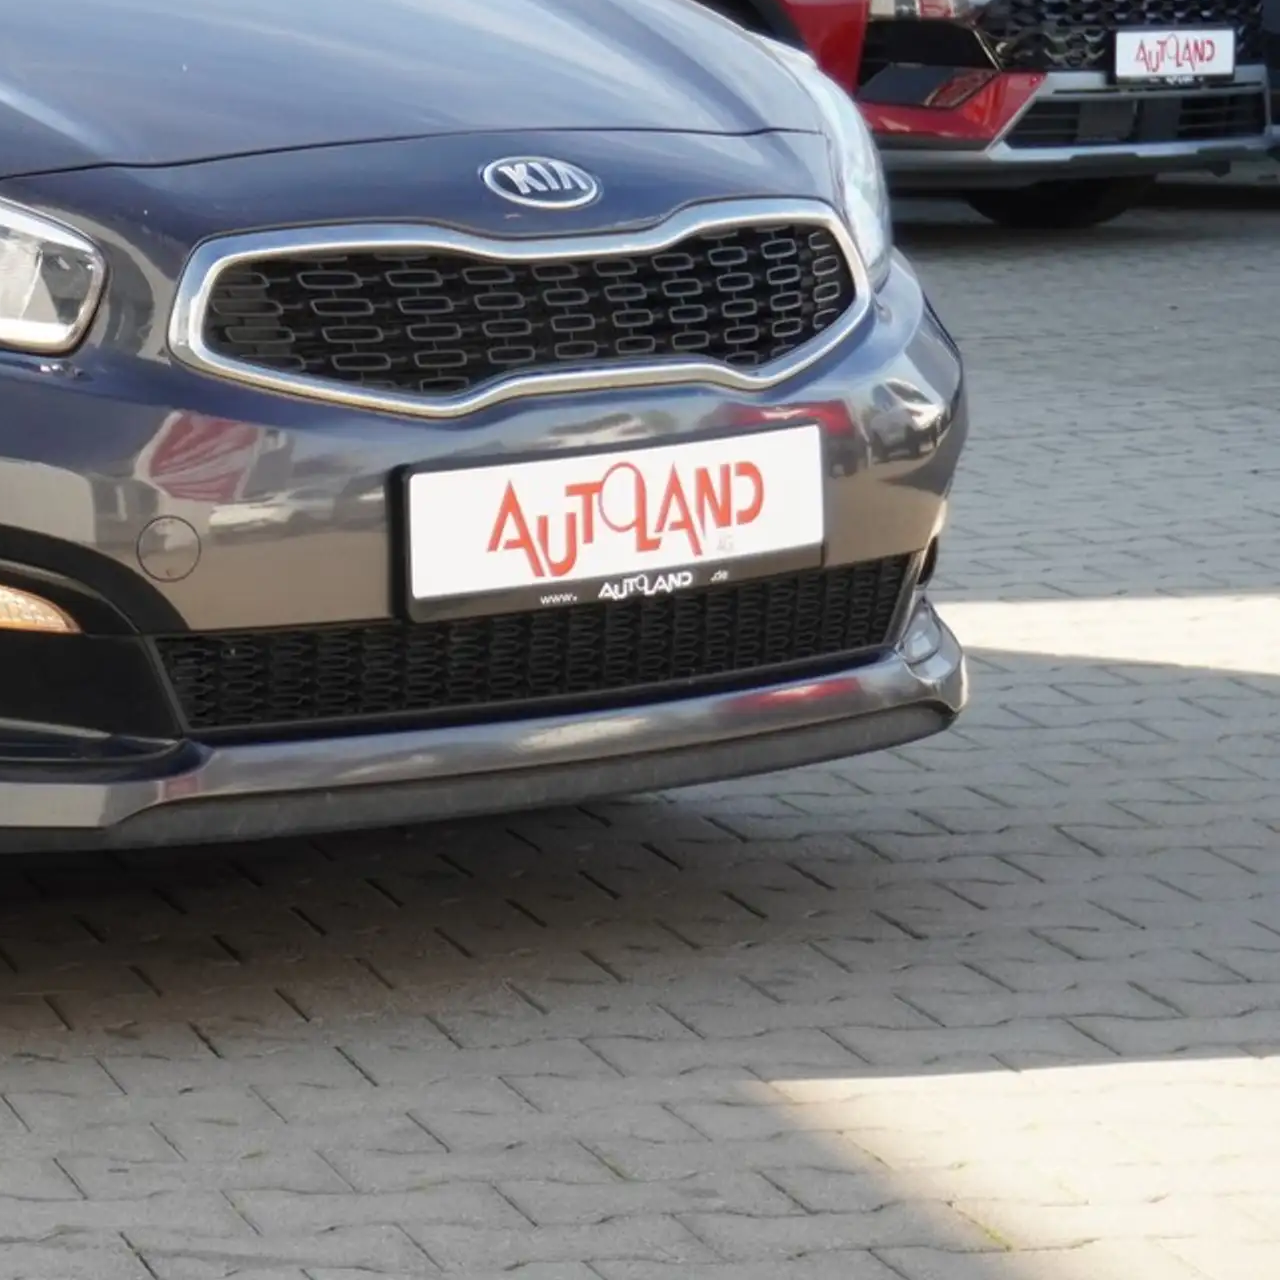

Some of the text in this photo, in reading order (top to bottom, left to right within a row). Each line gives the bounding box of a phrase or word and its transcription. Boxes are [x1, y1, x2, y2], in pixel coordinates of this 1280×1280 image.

[1134, 32, 1216, 73] AUTOLAND
[497, 160, 589, 195] KIA
[485, 460, 764, 578] AUTOLAND
[597, 570, 694, 600] AUTOLAND
